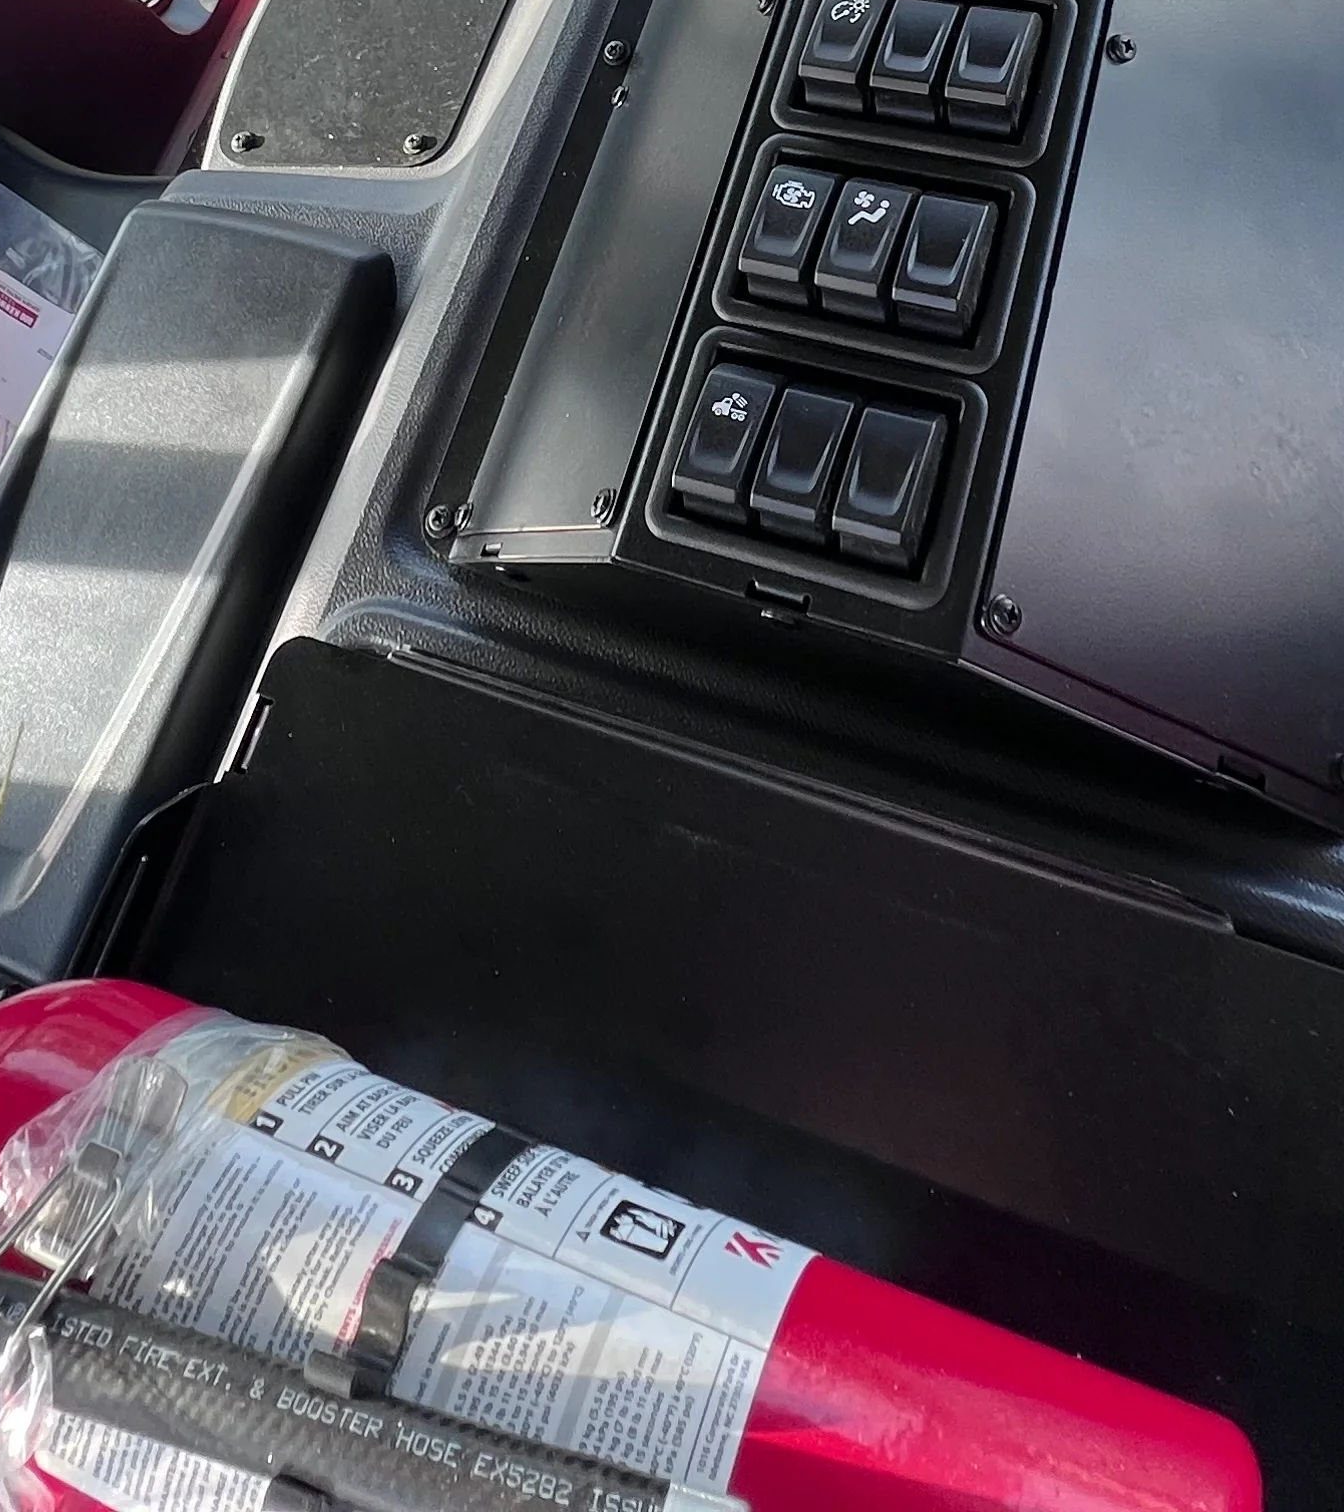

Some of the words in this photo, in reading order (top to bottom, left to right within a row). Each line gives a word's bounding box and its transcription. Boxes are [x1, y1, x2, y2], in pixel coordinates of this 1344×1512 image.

[256, 1112, 278, 1130] 1
[275, 1081, 306, 1108] PULL
[297, 1087, 332, 1117] TIRER
[355, 1110, 390, 1143] VISER
[313, 1136, 338, 1159] 2
[334, 1108, 360, 1132] AIM
[375, 1130, 397, 1151] DU
[392, 1172, 416, 1192] 3
[411, 1123, 454, 1166] SQUEEZE
[471, 1207, 495, 1228] 4
[489, 1161, 525, 1200] SWEEP
[515, 1164, 557, 1210] BALAYER
[171, 1202, 210, 1258] frequently
[180, 1223, 210, 1267] damage
[188, 1222, 222, 1271] indicator
[236, 1229, 272, 1287] performed
[522, 1337, 547, 1386] seconds
[117, 1334, 179, 1373] FIRE
[181, 1352, 237, 1391] EXT.
[247, 1374, 269, 1402] &
[275, 1383, 386, 1443] BOOSTER
[393, 1424, 464, 1469] HOSE
[471, 1450, 573, 1506] EX5282
[638, 1389, 666, 1448] secondes
